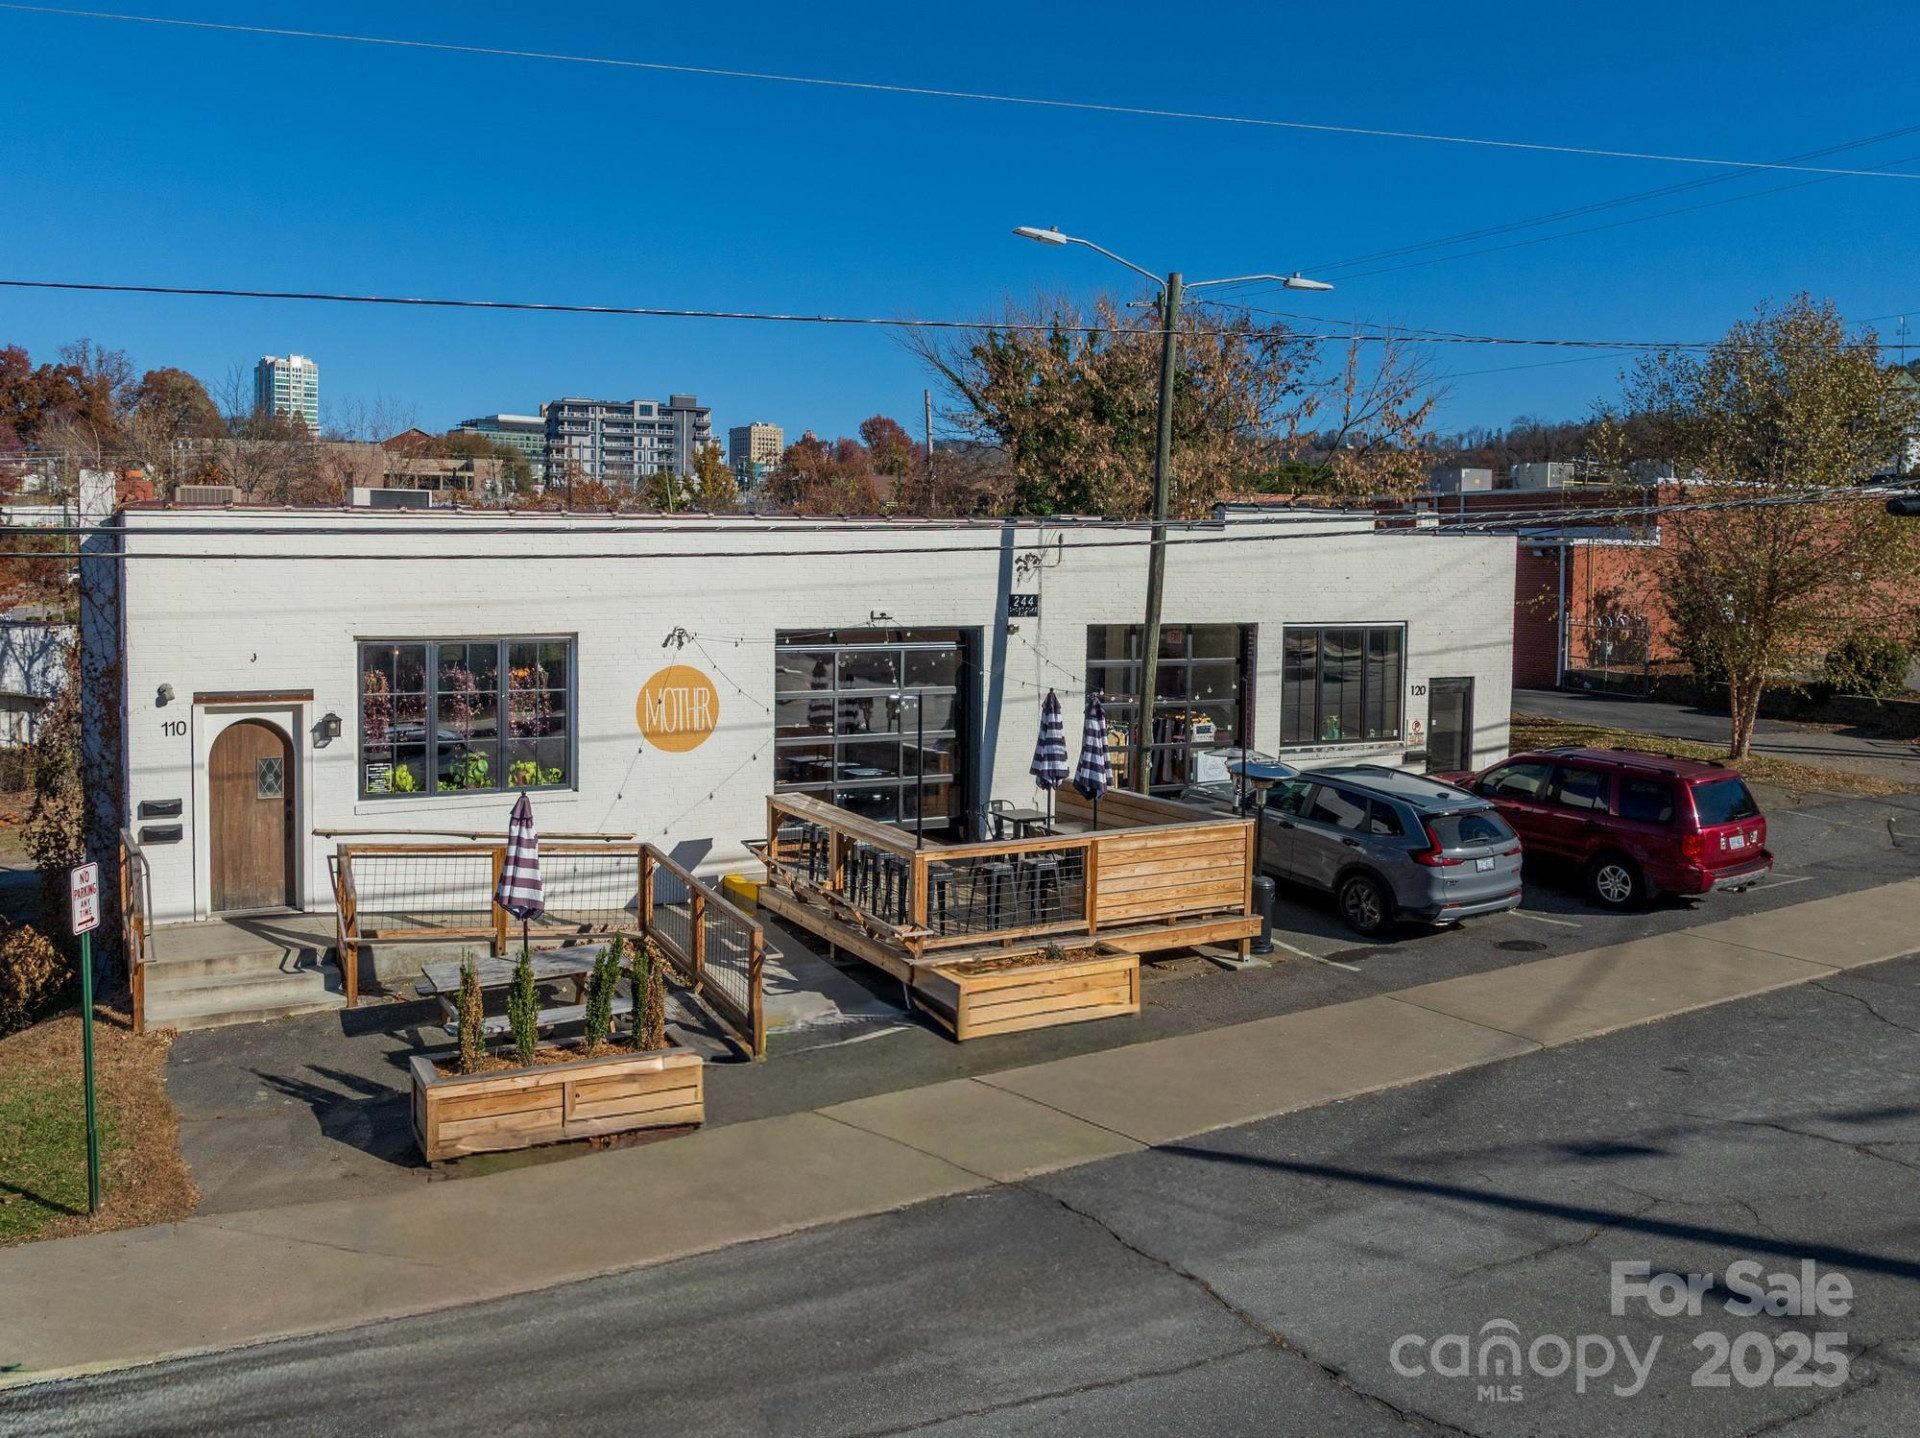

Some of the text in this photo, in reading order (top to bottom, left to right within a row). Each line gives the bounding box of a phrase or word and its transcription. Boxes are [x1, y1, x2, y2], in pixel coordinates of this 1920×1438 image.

[1013, 595, 1034, 606] 244
[1411, 685, 1426, 696] 120
[645, 687, 713, 733] MOTHER
[160, 720, 187, 737] 110
[79, 871, 90, 884] NO
[74, 882, 97, 900] PARKING
